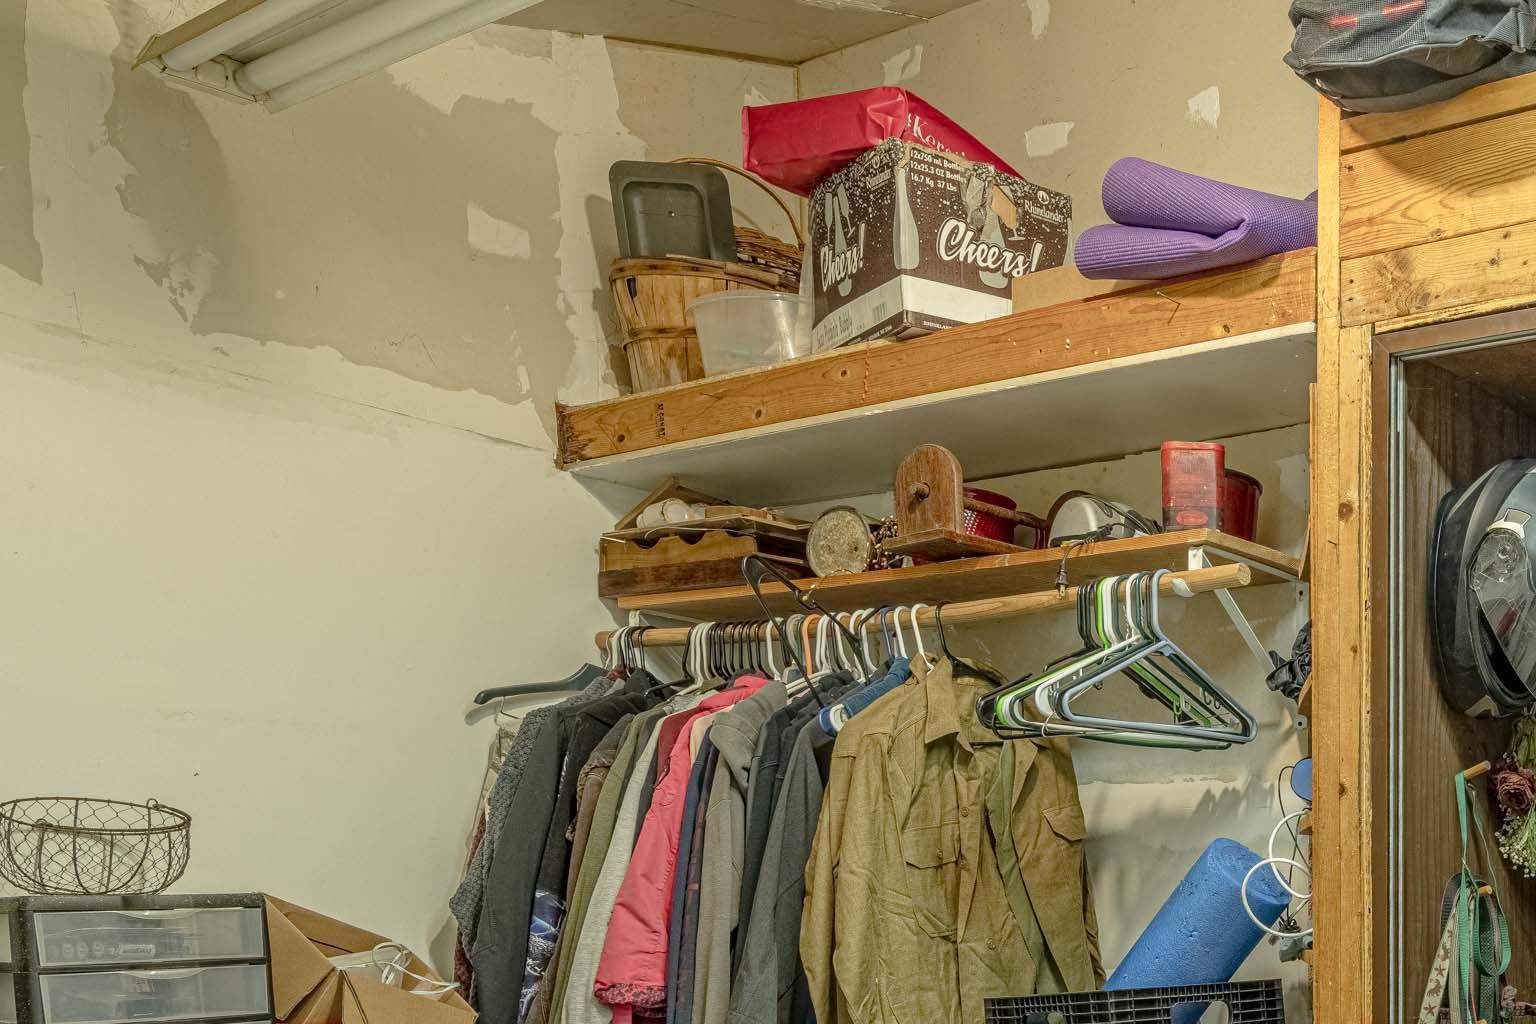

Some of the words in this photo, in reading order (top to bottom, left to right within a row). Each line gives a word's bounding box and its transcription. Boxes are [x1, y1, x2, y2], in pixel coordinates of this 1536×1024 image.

[911, 150, 932, 163] 12x750
[911, 161, 934, 174] 12x25.3
[935, 168, 945, 177] OZ
[911, 172, 924, 182] 16.7
[925, 177, 934, 187] Kg
[937, 180, 945, 188] 37
[946, 182, 957, 192] Lbs
[820, 222, 866, 292] Cheers!
[936, 218, 1043, 278] Cheers!
